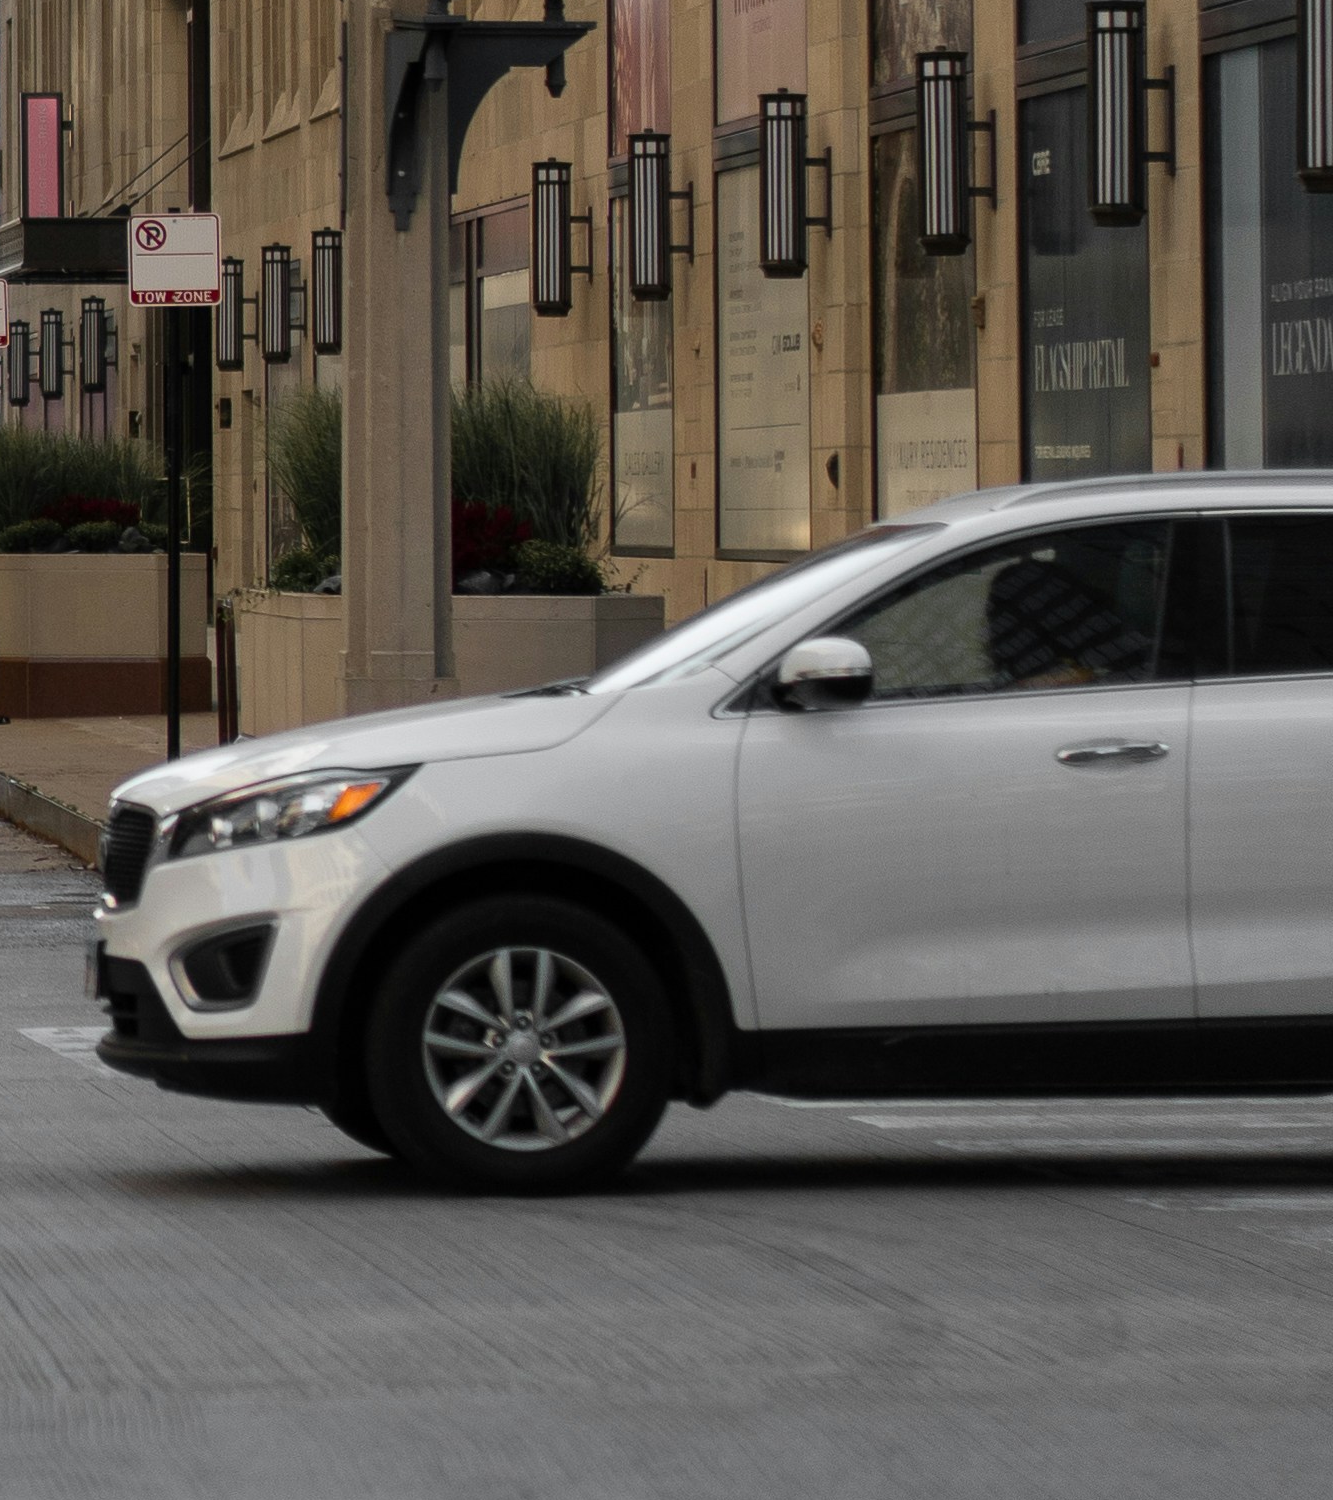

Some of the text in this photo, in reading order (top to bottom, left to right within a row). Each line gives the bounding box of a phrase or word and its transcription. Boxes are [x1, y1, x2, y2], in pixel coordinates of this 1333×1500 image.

[136, 291, 213, 303] TOW ZONE
[1035, 337, 1130, 392] FLAGSHIP RETAIL
